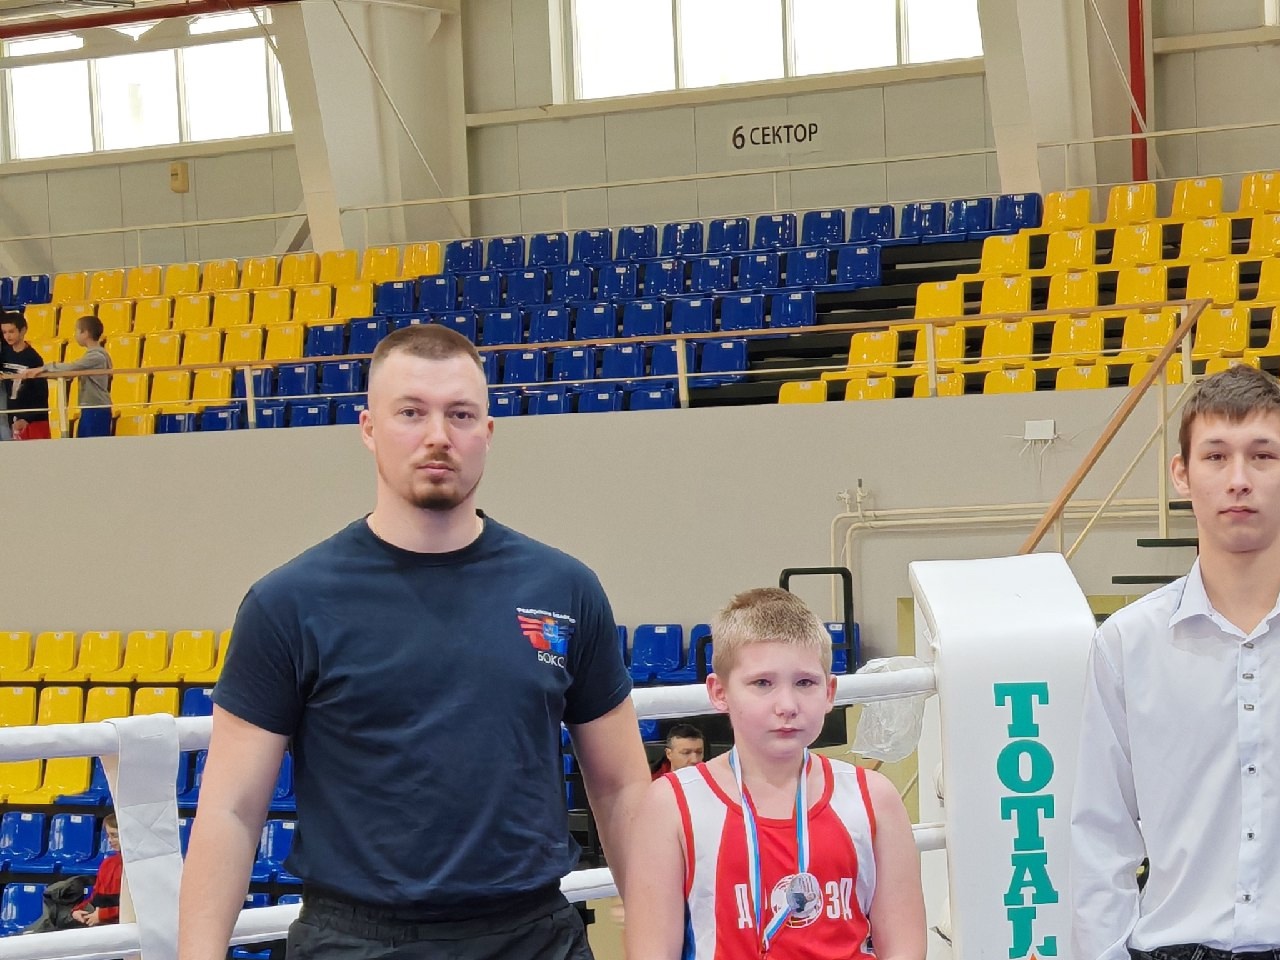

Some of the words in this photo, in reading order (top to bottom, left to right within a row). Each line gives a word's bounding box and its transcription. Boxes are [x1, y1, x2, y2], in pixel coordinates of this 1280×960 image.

[732, 125, 746, 150] 6
[750, 123, 818, 145] СЕКТОР
[537, 650, 565, 669] БОКС
